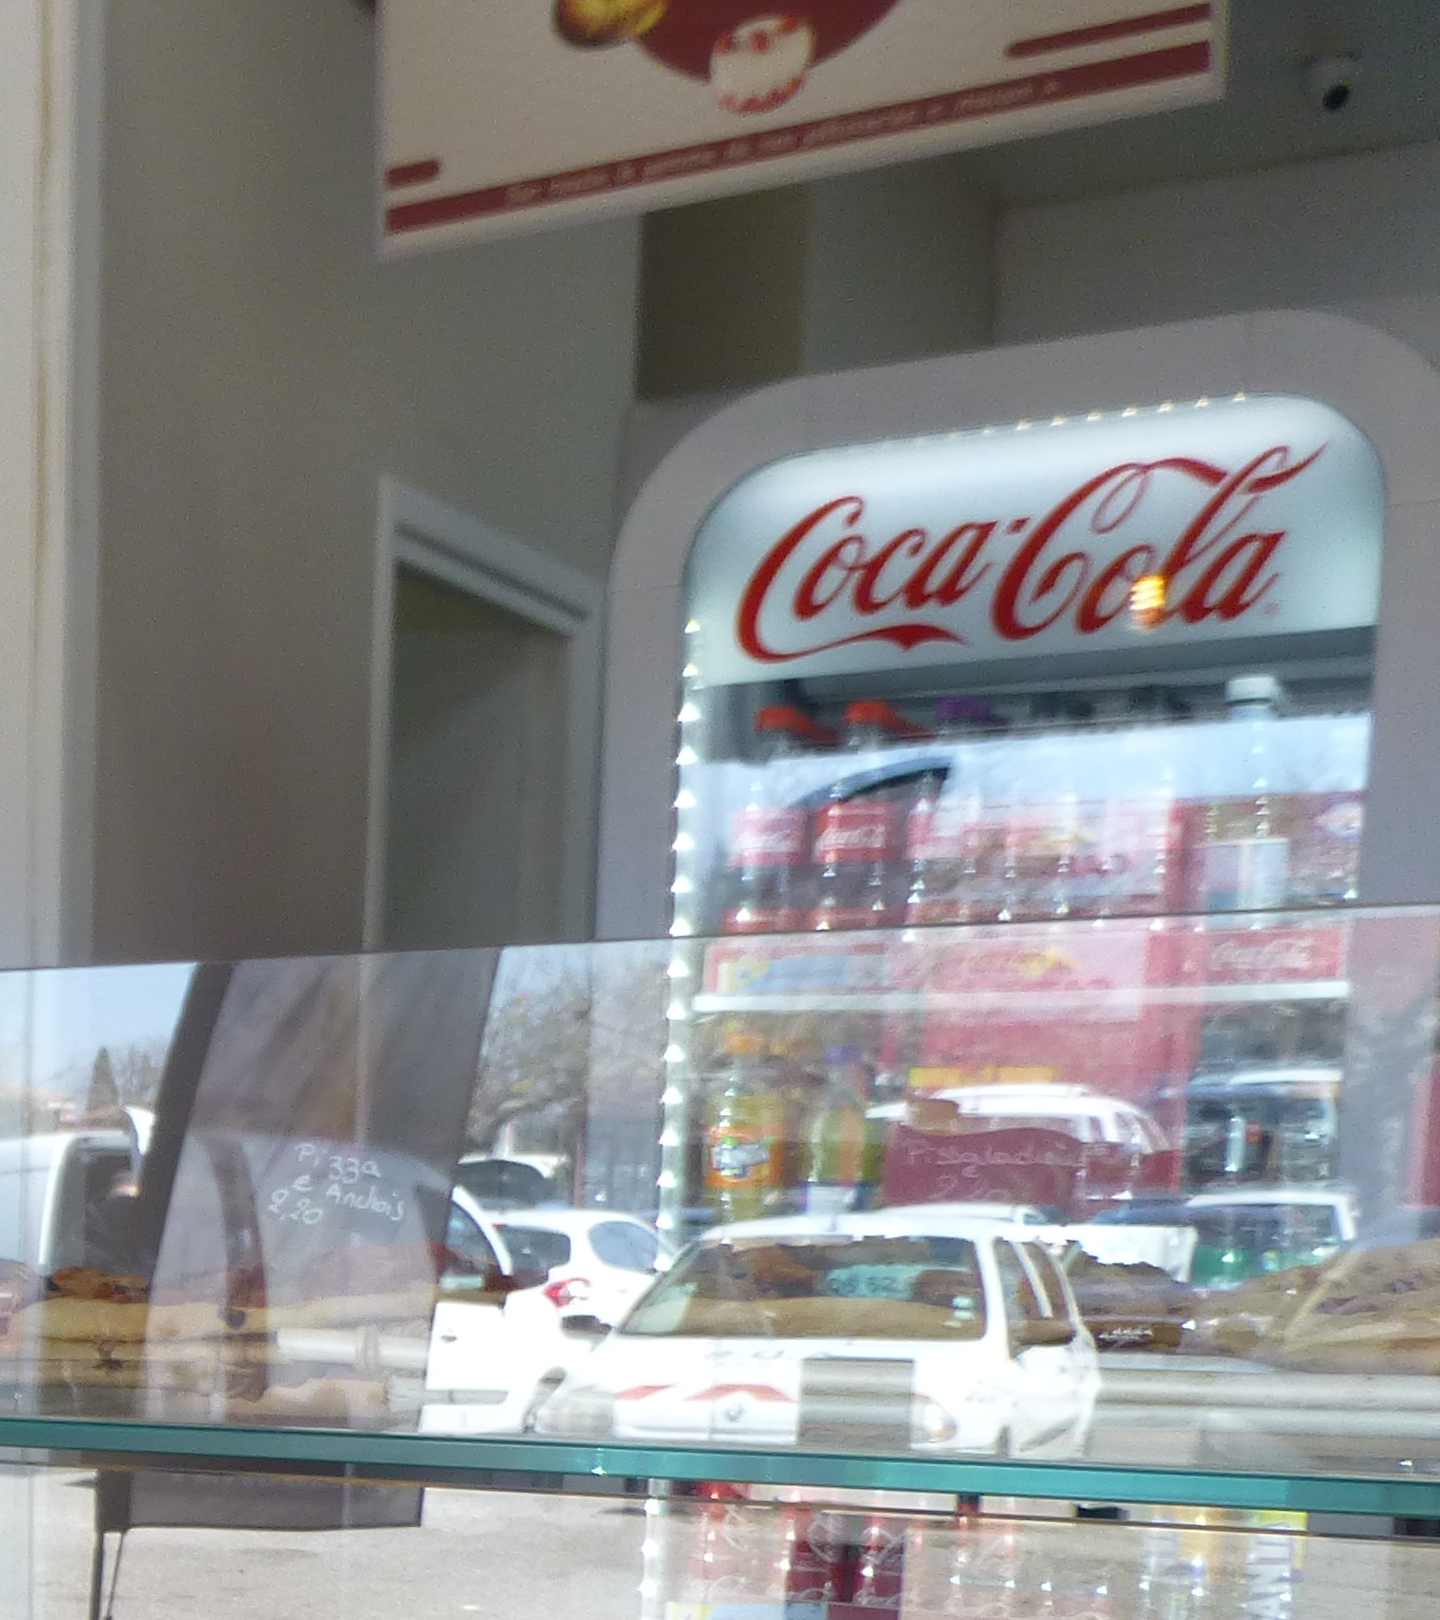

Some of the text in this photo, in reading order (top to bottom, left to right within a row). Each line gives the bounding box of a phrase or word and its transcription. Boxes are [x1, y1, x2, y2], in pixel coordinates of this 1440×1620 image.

[736, 440, 1326, 662] Coca-Cola
[267, 1187, 324, 1225] 2,20
[325, 1182, 406, 1222] Anchois
